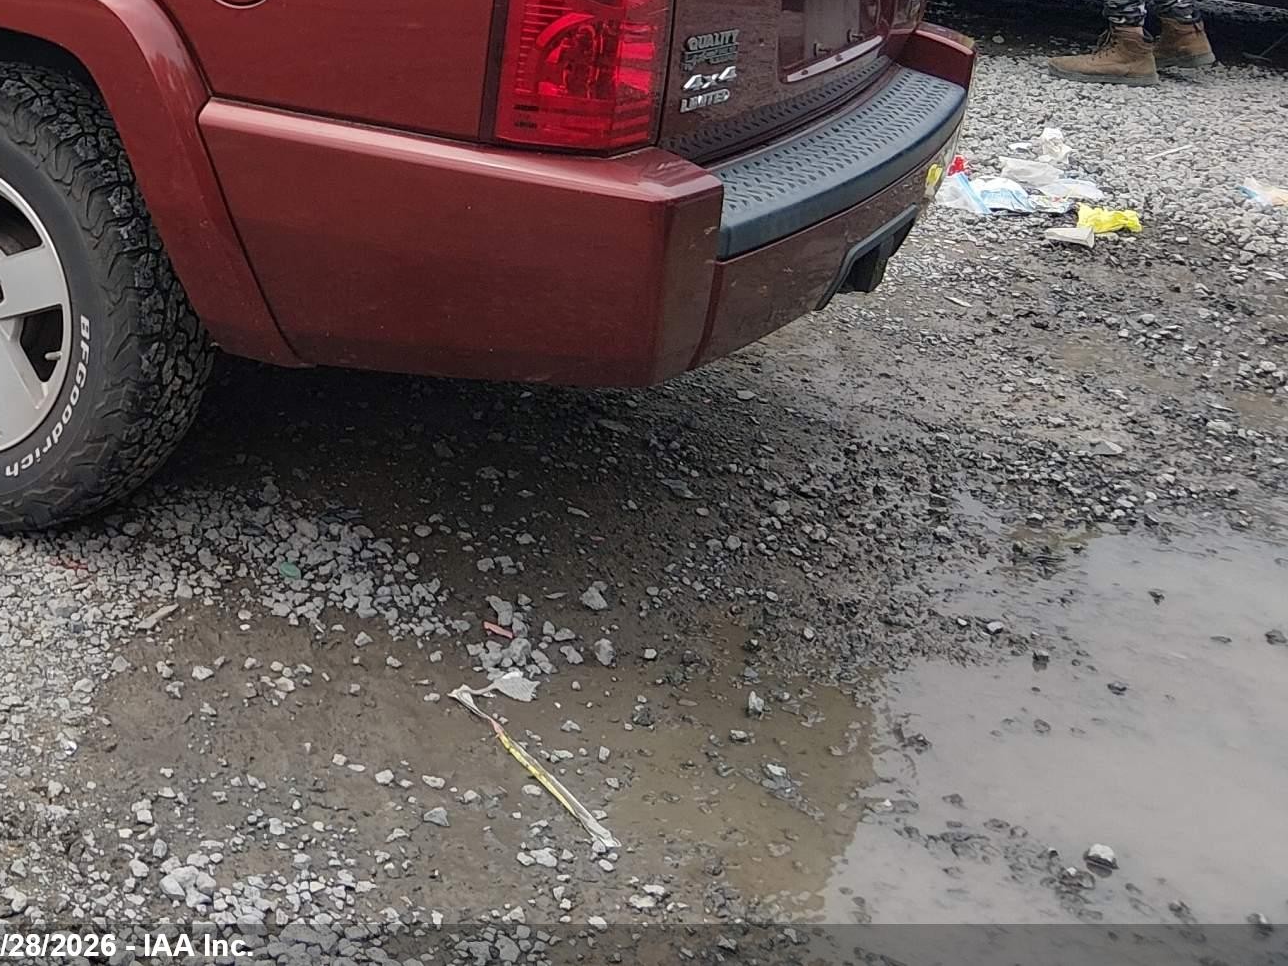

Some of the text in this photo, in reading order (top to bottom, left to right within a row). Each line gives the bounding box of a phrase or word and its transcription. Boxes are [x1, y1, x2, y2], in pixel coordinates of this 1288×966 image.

[686, 28, 741, 51] QUALITY
[679, 88, 731, 114] LIMITED
[4, 313, 91, 478] BFGoodrich
